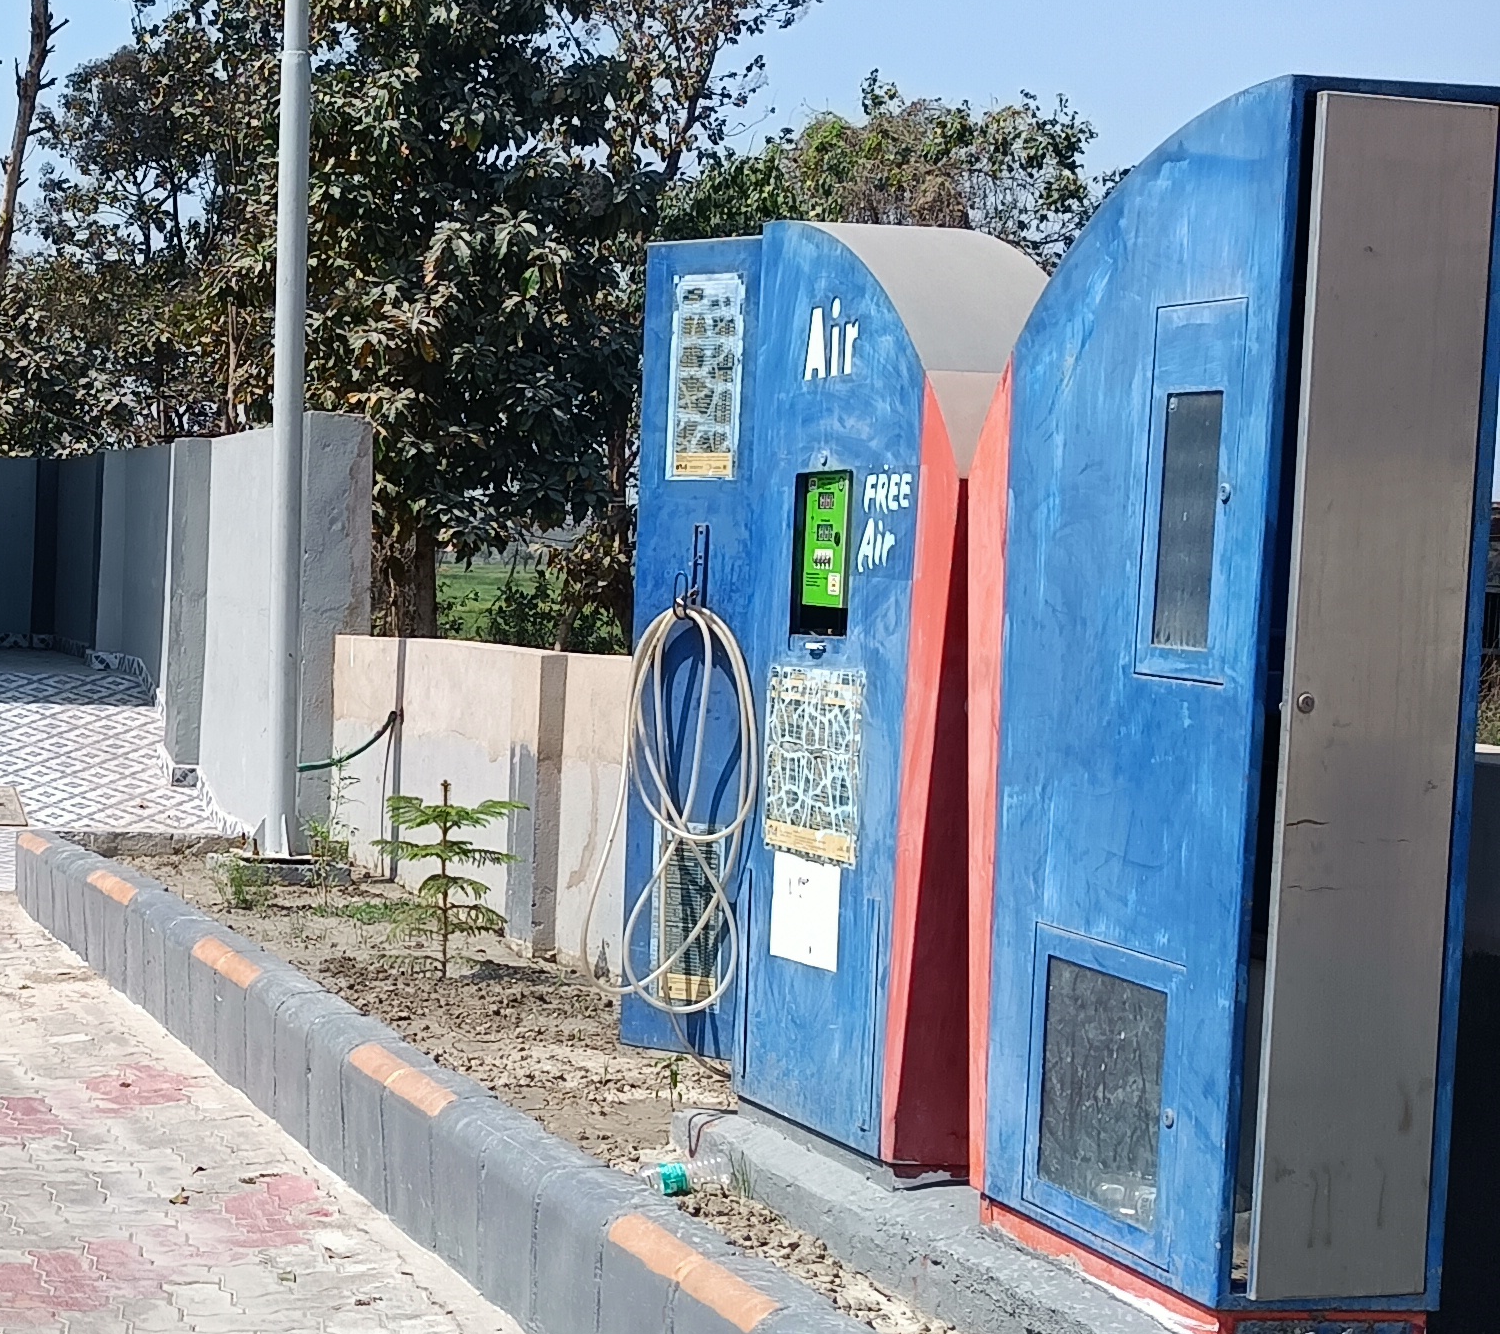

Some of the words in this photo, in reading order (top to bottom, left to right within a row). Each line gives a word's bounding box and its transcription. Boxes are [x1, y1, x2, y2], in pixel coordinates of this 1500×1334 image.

[803, 296, 859, 381] Air
[863, 473, 912, 514] FREE
[857, 517, 895, 572] Air
